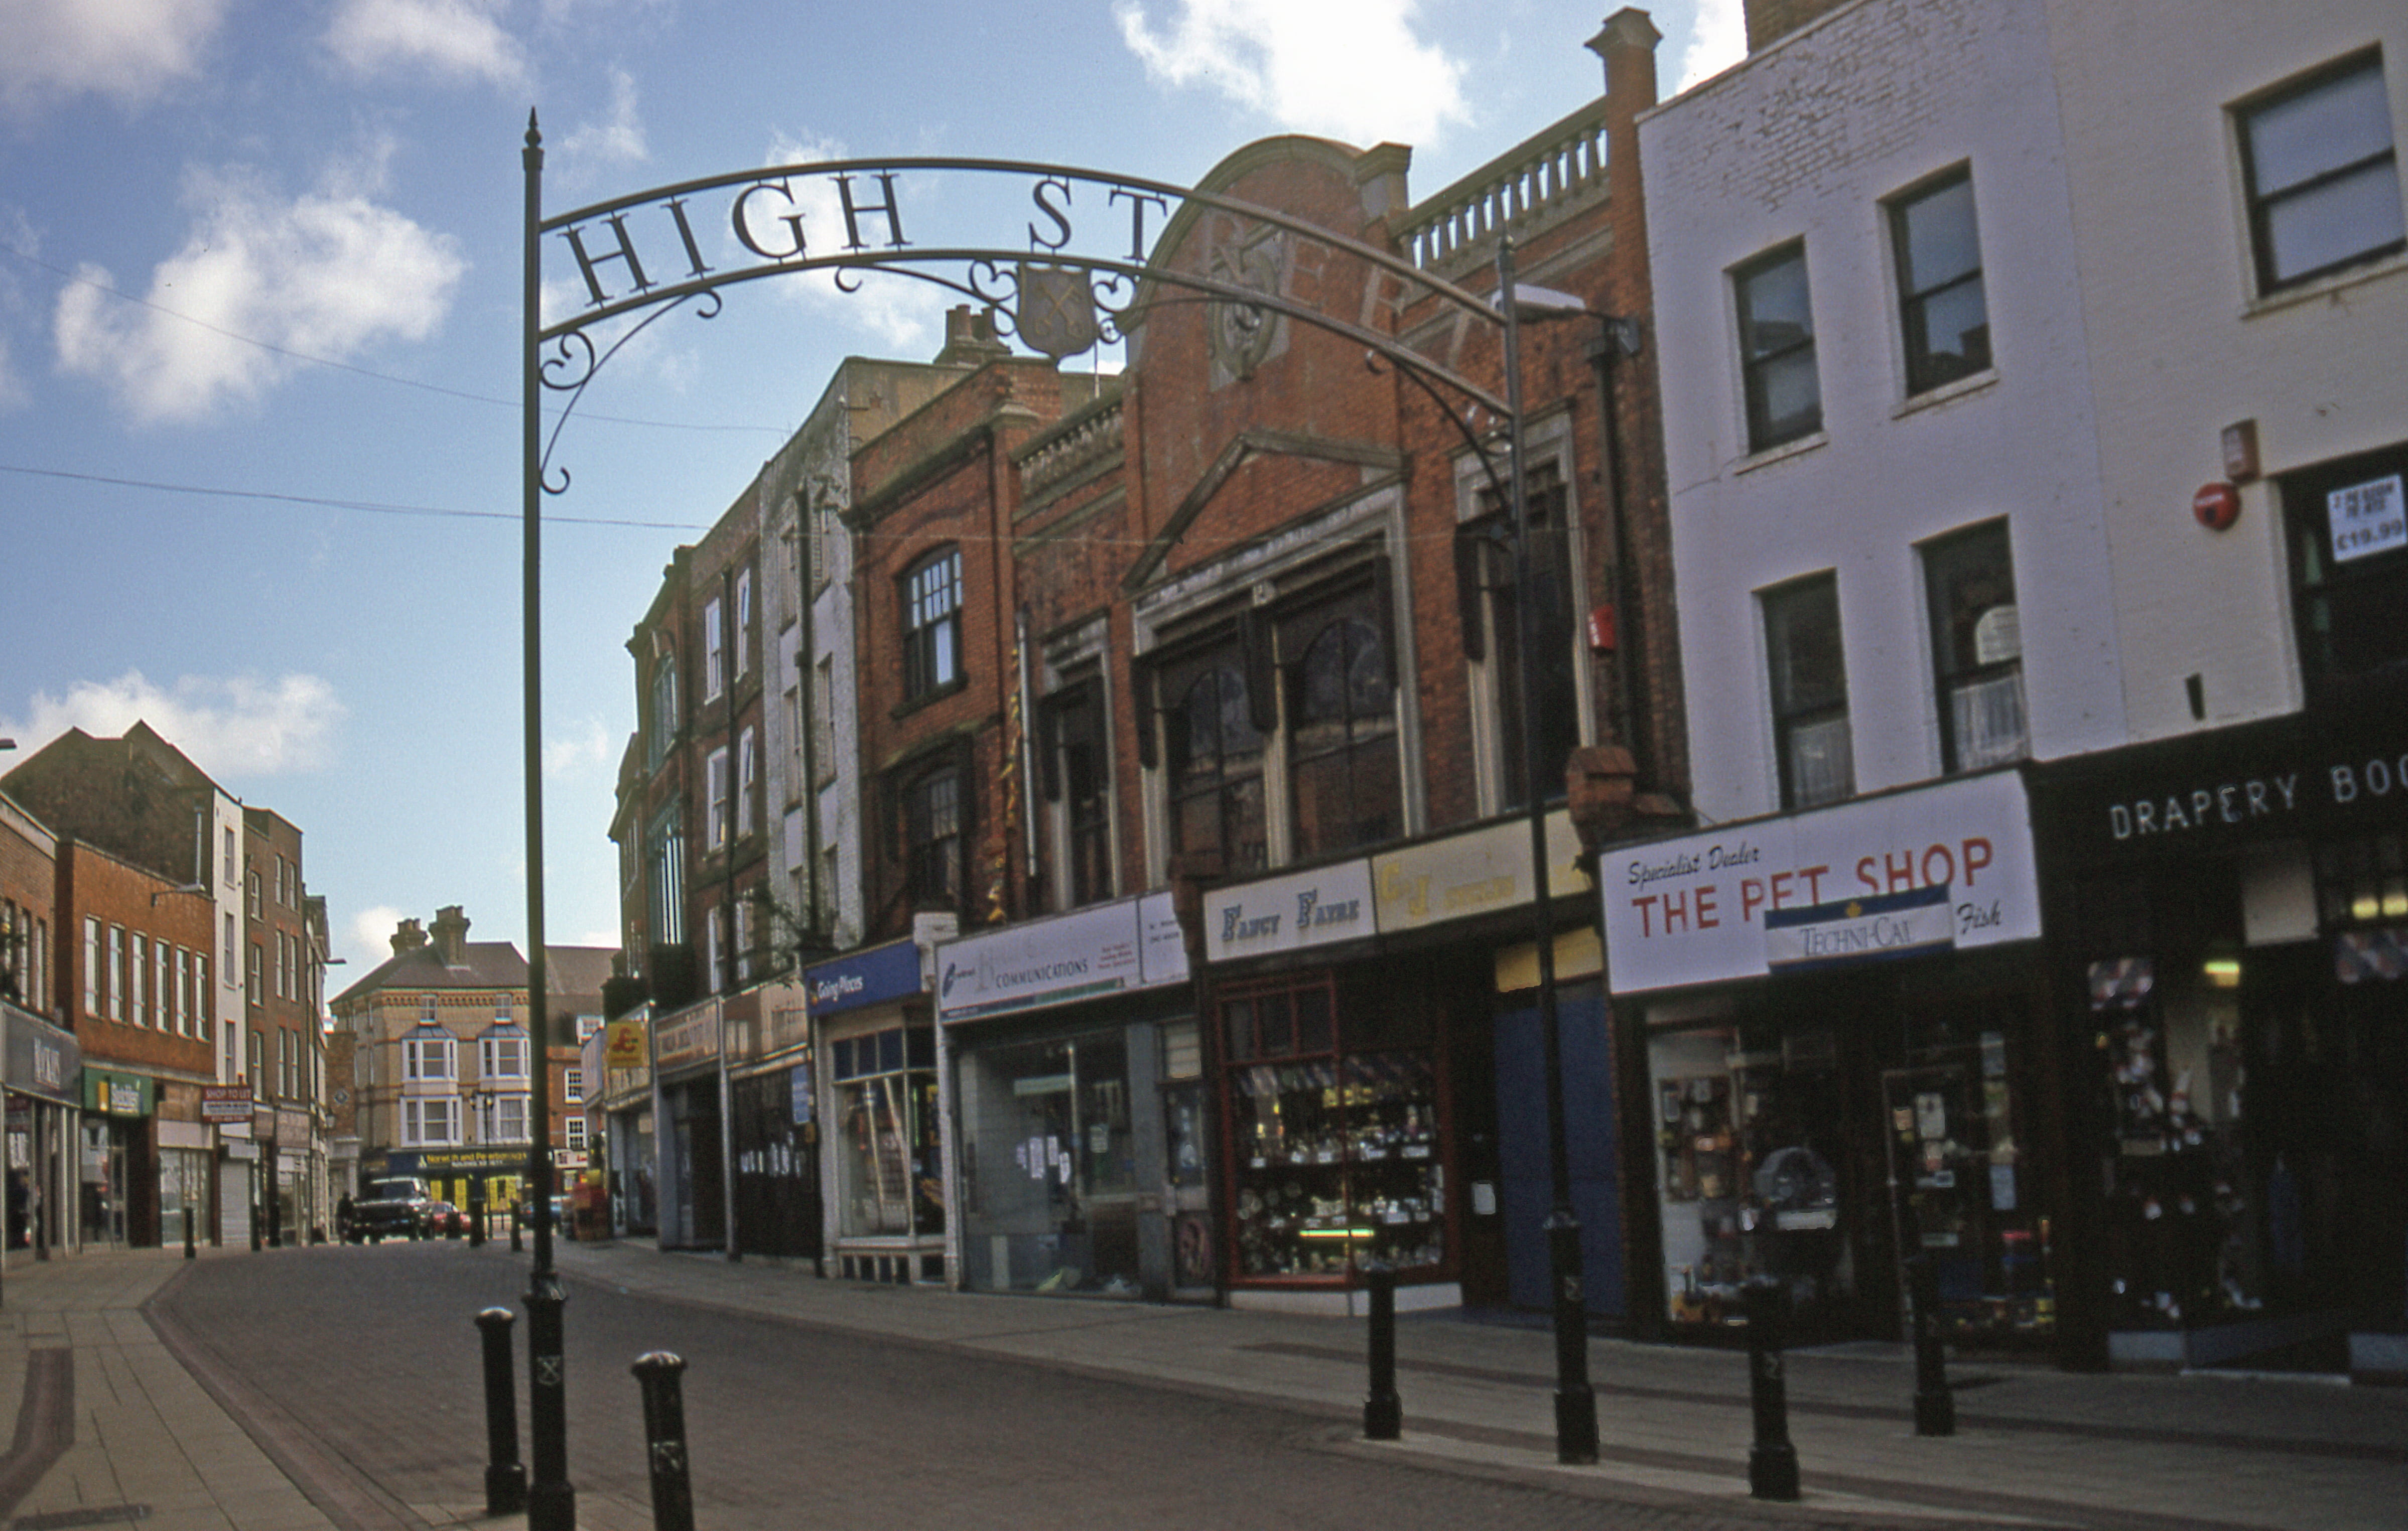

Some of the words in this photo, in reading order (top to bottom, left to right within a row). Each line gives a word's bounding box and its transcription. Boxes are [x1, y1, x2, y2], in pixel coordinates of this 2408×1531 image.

[558, 173, 913, 308] HIGH
[1028, 176, 1168, 262] ST
[2109, 773, 2299, 840] DRAPERY
[1628, 852, 1701, 889] Specialist
[1709, 841, 1761, 871] Dealer
[1632, 885, 1719, 938] THE
[1741, 864, 1829, 922] PET
[1855, 838, 1993, 895] SHOP
[1221, 904, 1281, 941] FANCY
[1296, 888, 1360, 929] FAYRE
[1956, 899, 2003, 935] Fish
[995, 957, 1089, 989] COMMUNICATIONS
[228, 1089, 238, 1098] TO
[239, 1089, 251, 1098] LET
